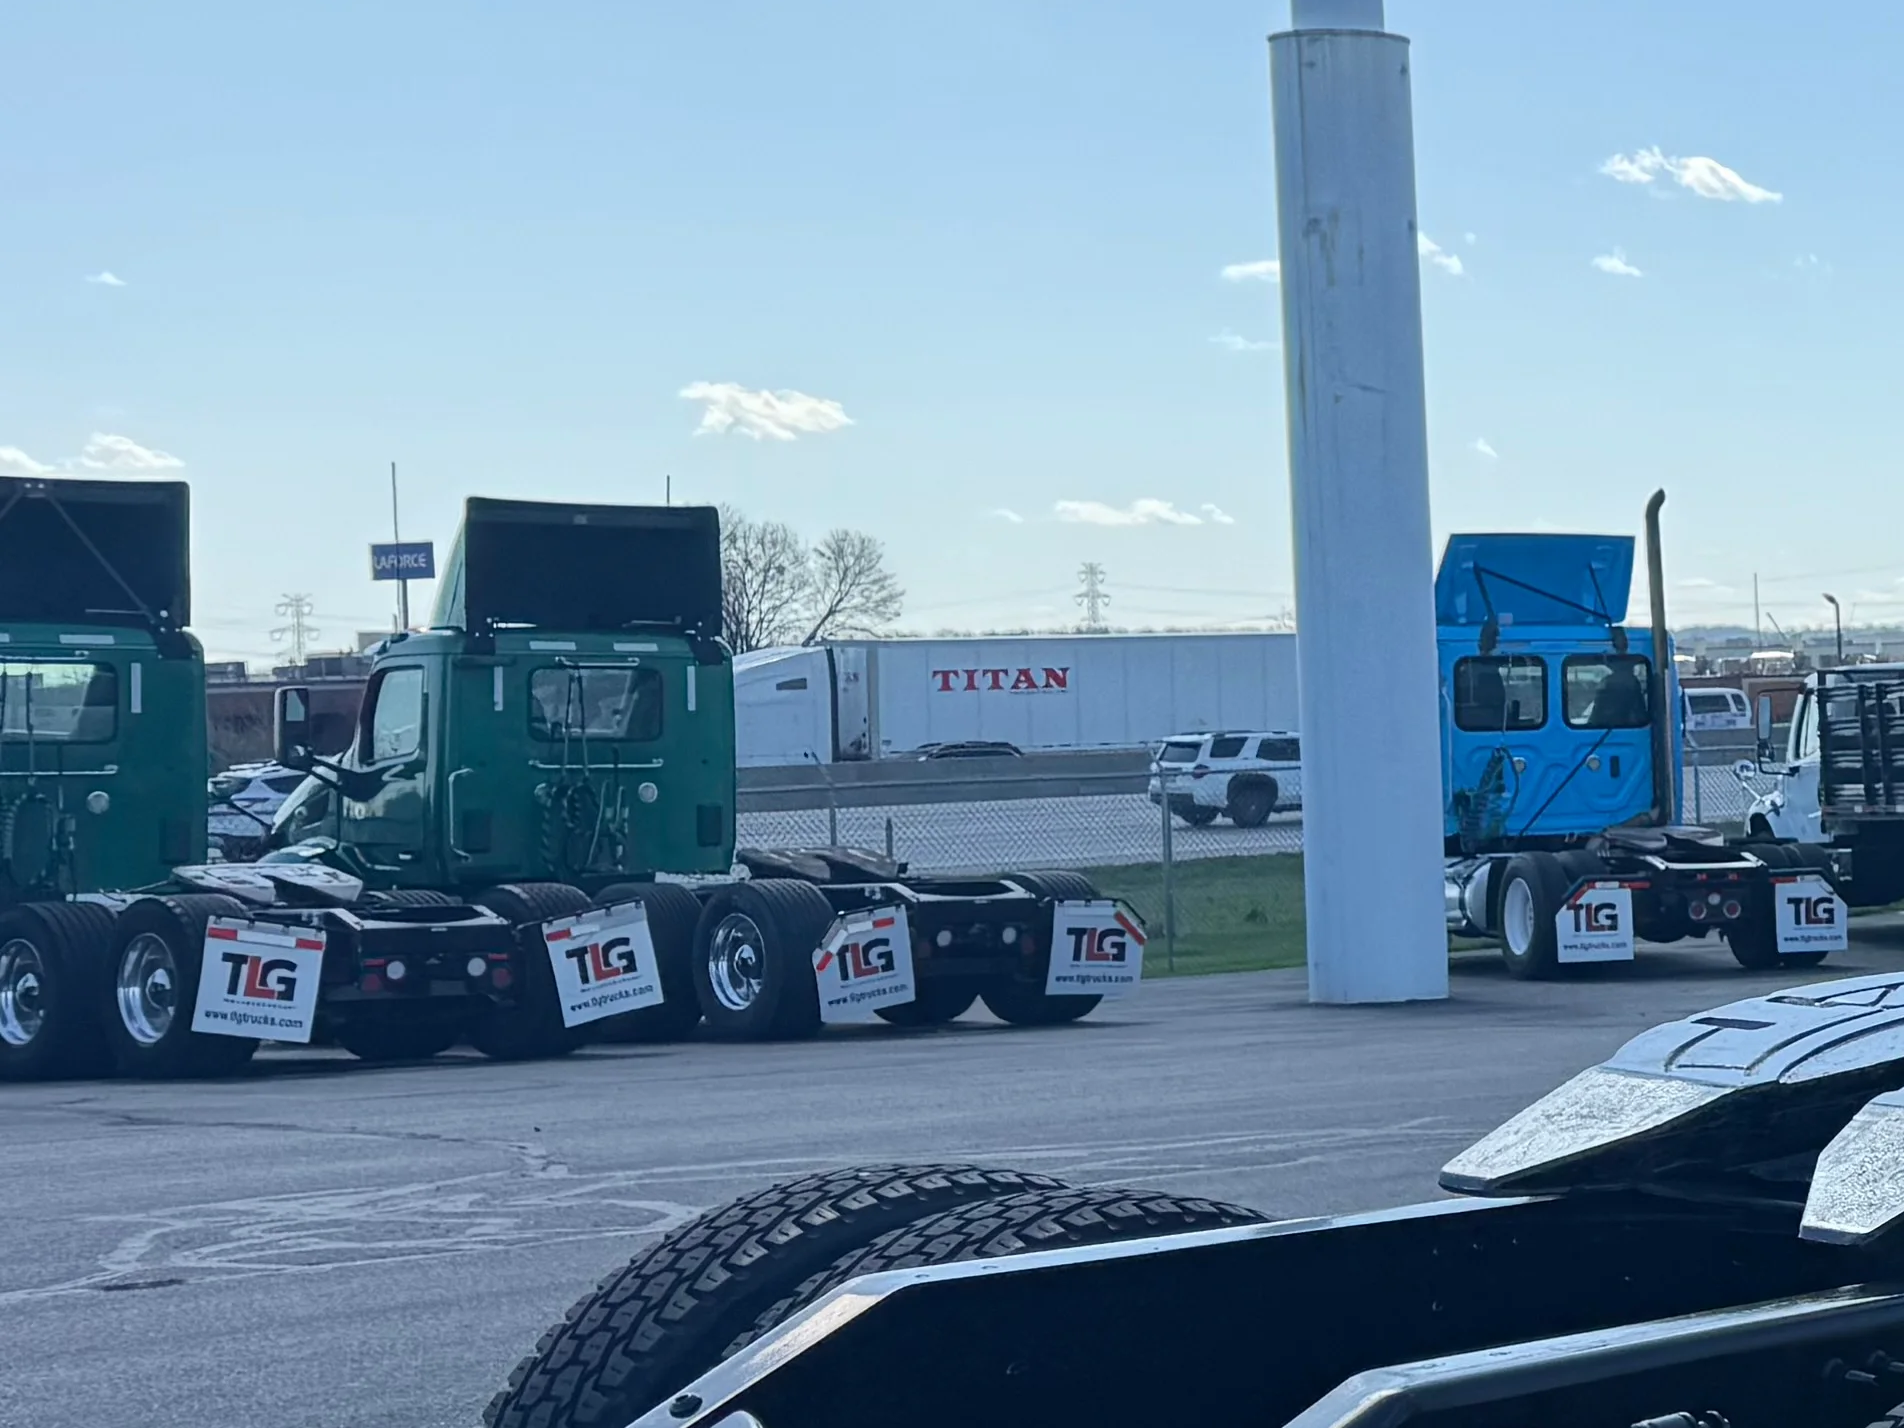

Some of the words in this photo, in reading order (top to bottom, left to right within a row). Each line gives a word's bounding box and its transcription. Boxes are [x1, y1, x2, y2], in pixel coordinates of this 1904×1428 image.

[932, 667, 1070, 693] TITAN
[1566, 902, 1618, 932] TLG
[1787, 896, 1835, 925] TLG
[565, 937, 638, 985] TLG
[836, 938, 895, 981] TLG
[1066, 927, 1126, 962] TLG
[221, 952, 298, 1002] TLG
